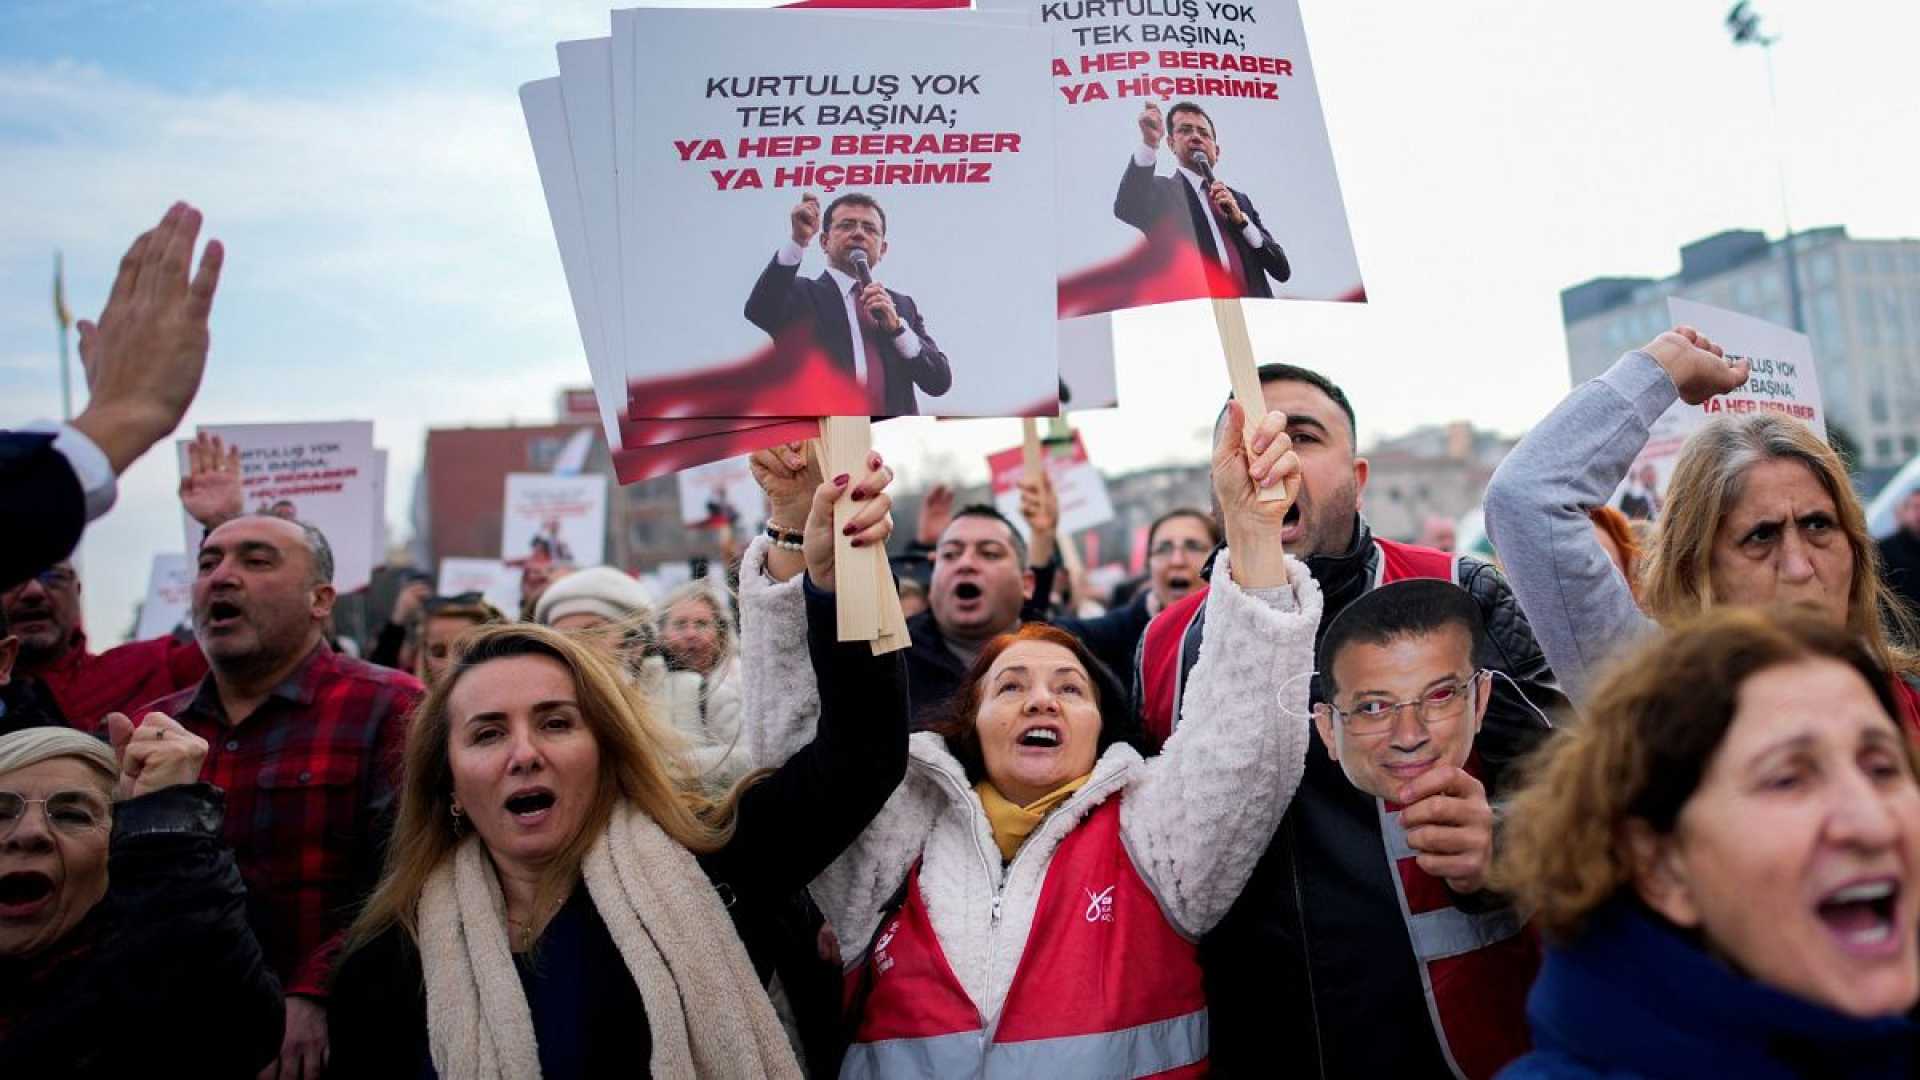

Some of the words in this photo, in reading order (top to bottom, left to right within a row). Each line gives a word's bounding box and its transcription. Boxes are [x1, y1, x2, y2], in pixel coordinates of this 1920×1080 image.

[1042, 0, 1200, 23] KURTULUŞ
[1207, 2, 1256, 24] YOK
[1072, 25, 1133, 46] TEK
[1142, 24, 1246, 52] BAŞINA;
[1052, 58, 1072, 77] A
[1081, 51, 1151, 74] HEP
[1158, 51, 1293, 76] BERABER
[706, 75, 899, 101] KURTULUŞ
[912, 75, 980, 95] YOK
[1060, 82, 1109, 105] YA
[1117, 73, 1280, 101] HİÇBİRİMİZ
[736, 106, 805, 127] TEK
[817, 104, 956, 131] BAŞINA;
[674, 140, 725, 161] YA
[740, 135, 821, 158] HEP
[832, 132, 1020, 156] BERABER
[712, 169, 762, 190] YA
[775, 159, 992, 193] HİÇBİRİMİZ
[1775, 361, 1797, 377] YOK
